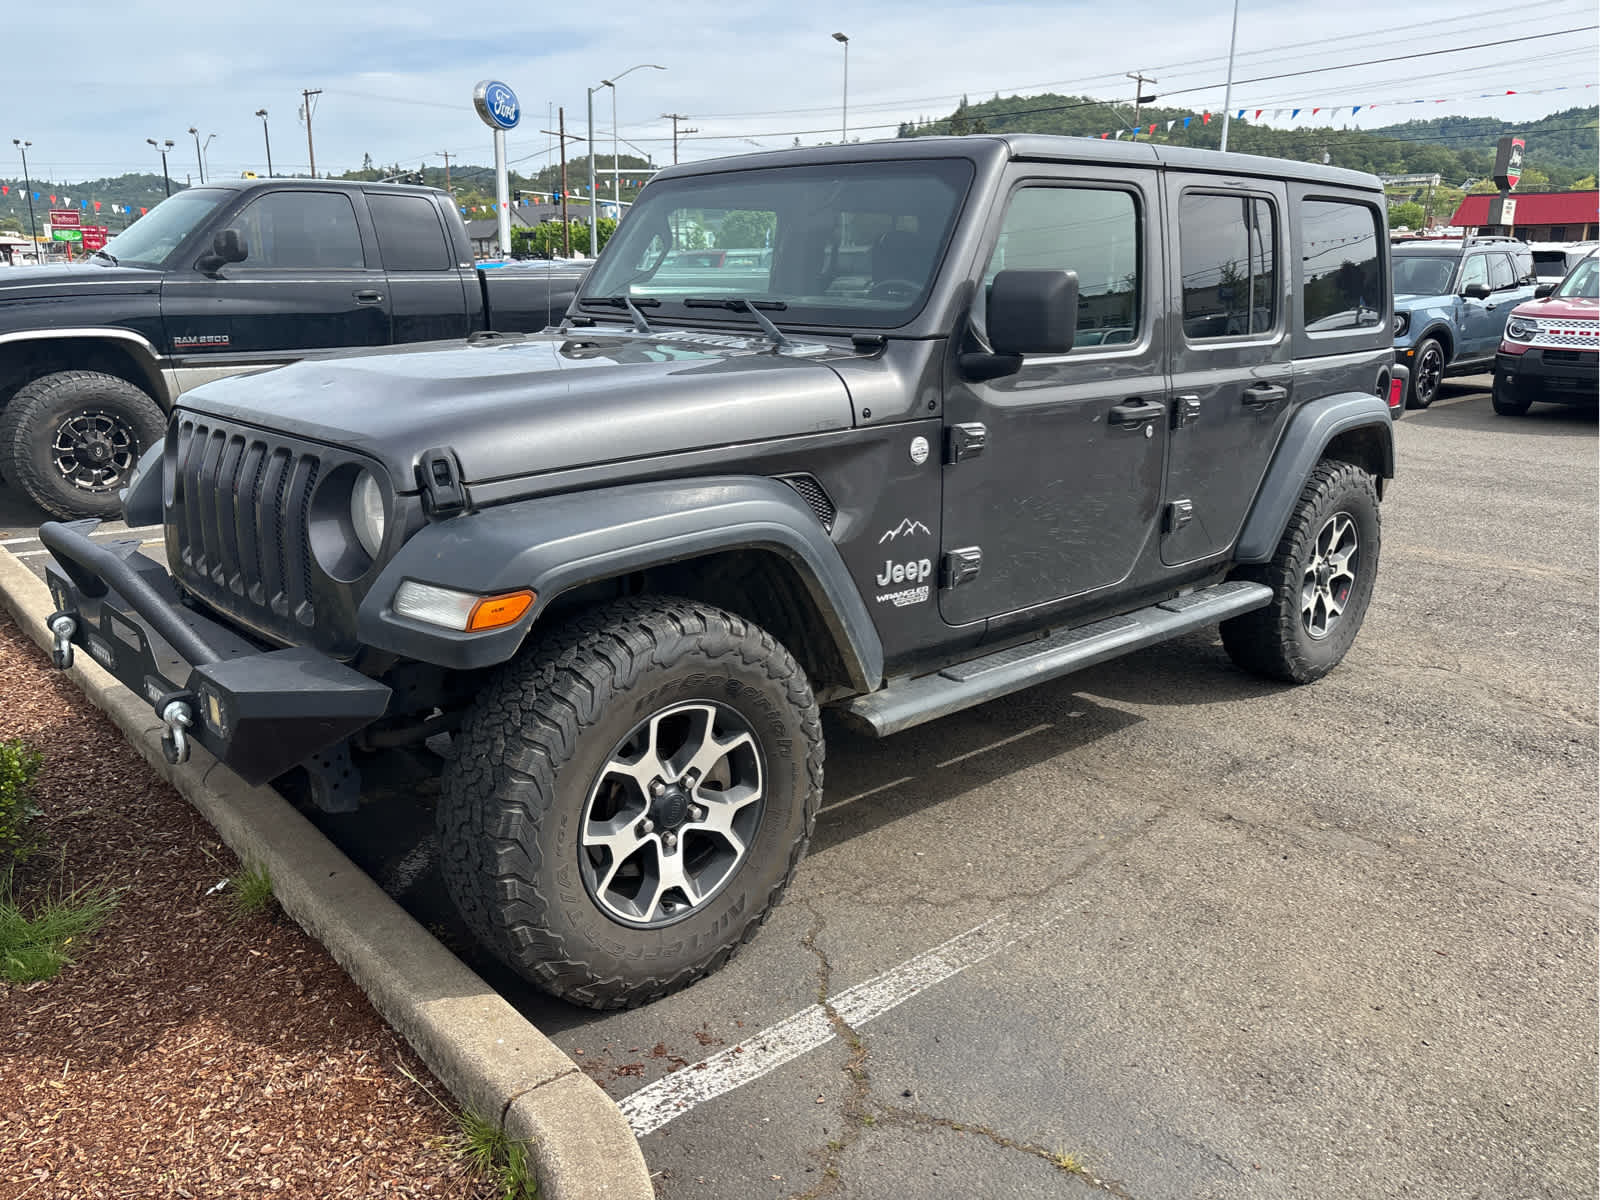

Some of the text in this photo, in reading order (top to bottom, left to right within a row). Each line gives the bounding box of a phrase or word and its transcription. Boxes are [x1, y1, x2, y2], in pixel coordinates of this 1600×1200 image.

[494, 89, 516, 120] Ford
[174, 336, 198, 344] RAM
[876, 558, 931, 586] Jeep
[876, 586, 929, 602] WRANGLER
